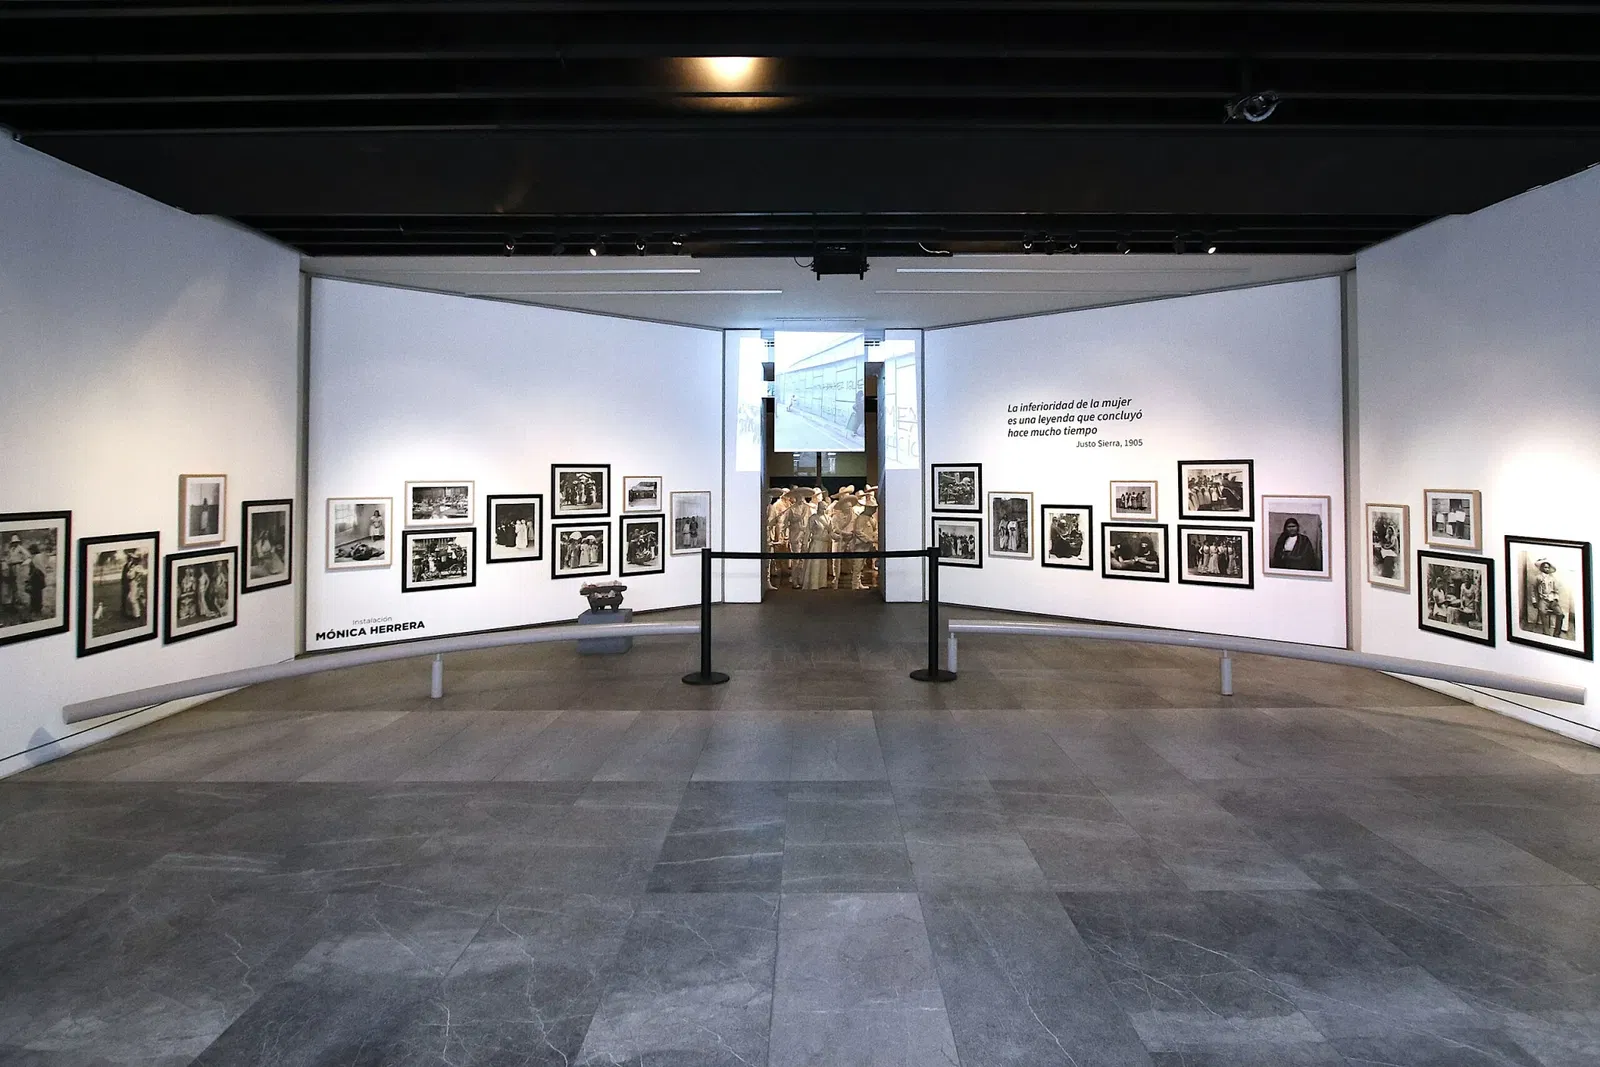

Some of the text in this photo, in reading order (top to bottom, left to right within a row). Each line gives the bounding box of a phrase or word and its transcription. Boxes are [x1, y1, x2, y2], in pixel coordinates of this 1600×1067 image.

[1008, 397, 1132, 413] La inferioridad de la mujer
[1008, 409, 1143, 425] es una leyenda que concluyó
[1008, 426, 1097, 437] hace mucho tiempo
[1076, 439, 1143, 448] Justo Sierra, 1905
[352, 616, 392, 625] Instalación
[316, 621, 425, 641] MÓNICA HERRERA
